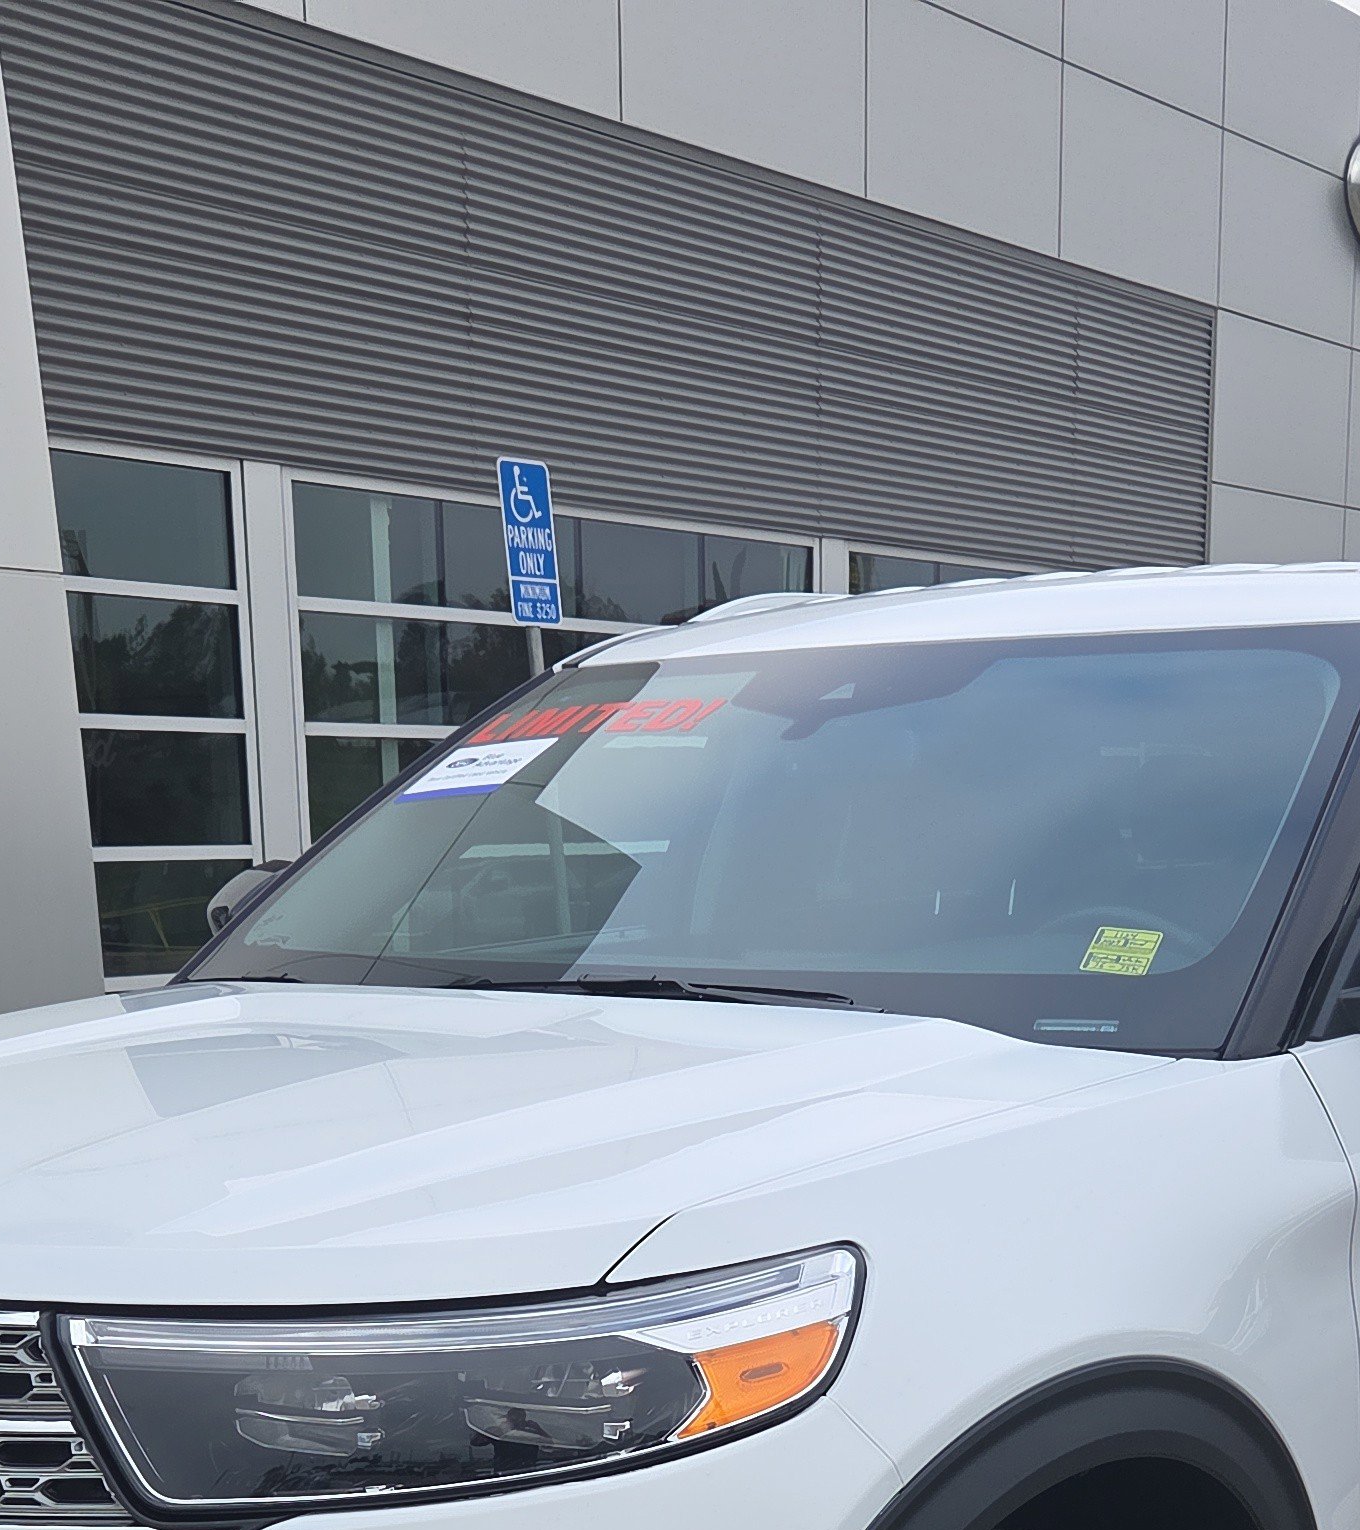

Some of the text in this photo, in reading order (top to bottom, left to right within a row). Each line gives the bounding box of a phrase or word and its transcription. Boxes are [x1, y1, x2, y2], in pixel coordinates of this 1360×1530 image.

[507, 524, 552, 552] PARKING
[518, 550, 545, 576] ONLY
[517, 601, 557, 620] FINE $250
[466, 696, 729, 746] LIMITED!
[687, 1299, 823, 1341] EXPLORER
